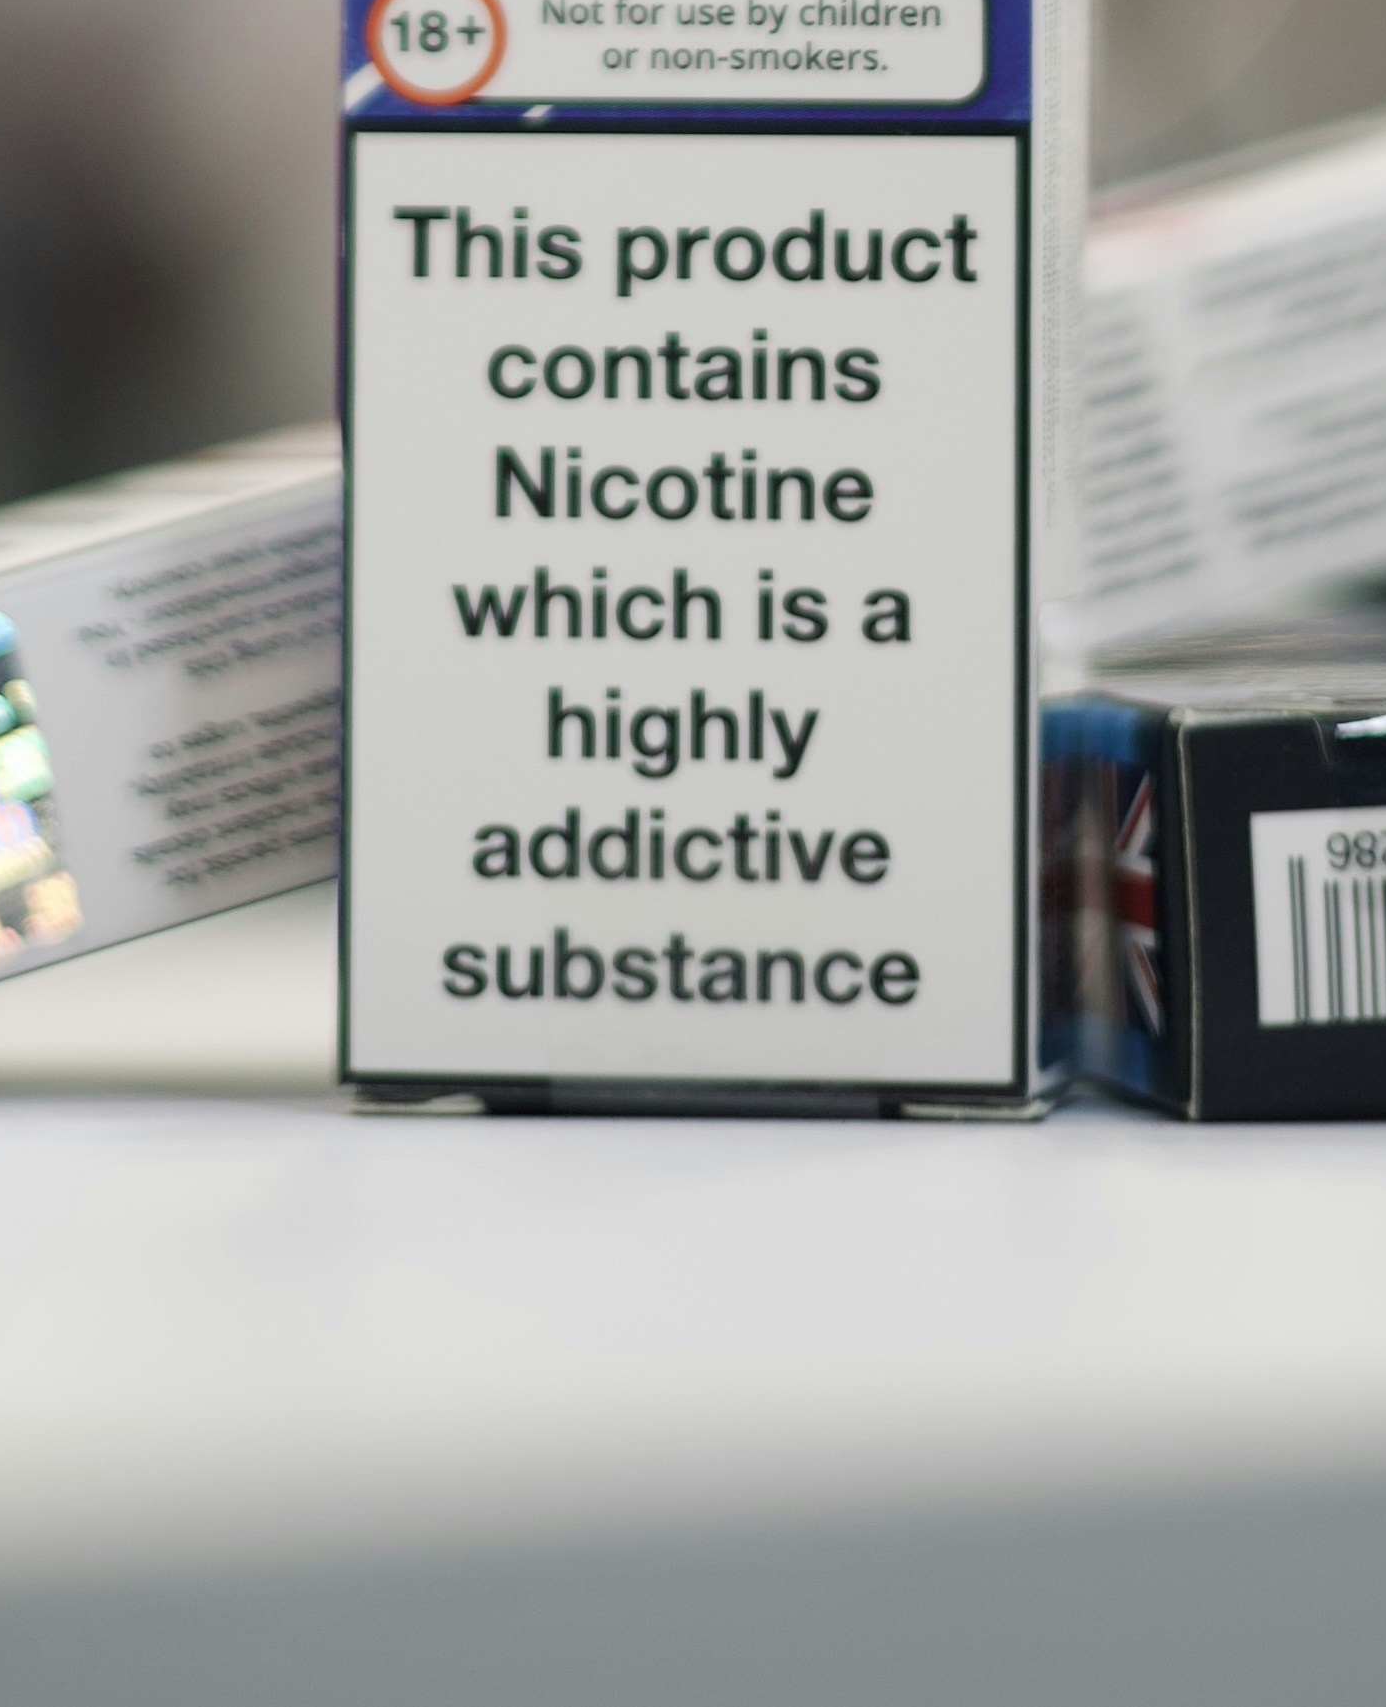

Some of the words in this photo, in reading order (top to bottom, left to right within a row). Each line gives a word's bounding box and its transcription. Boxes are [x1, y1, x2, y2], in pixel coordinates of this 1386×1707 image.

[389, 8, 488, 55] 18+
[676, 3, 736, 28] use
[600, 45, 638, 73] or
[649, 40, 890, 73] non-smokers.
[391, 205, 584, 282] This
[615, 208, 980, 299] product
[486, 327, 883, 404] contains
[494, 445, 875, 524] Nicotine
[451, 565, 723, 643] which
[757, 568, 830, 644] is
[860, 588, 913, 644] a
[546, 686, 820, 781] highly
[471, 806, 892, 886] addictive
[441, 926, 922, 1008] substance
